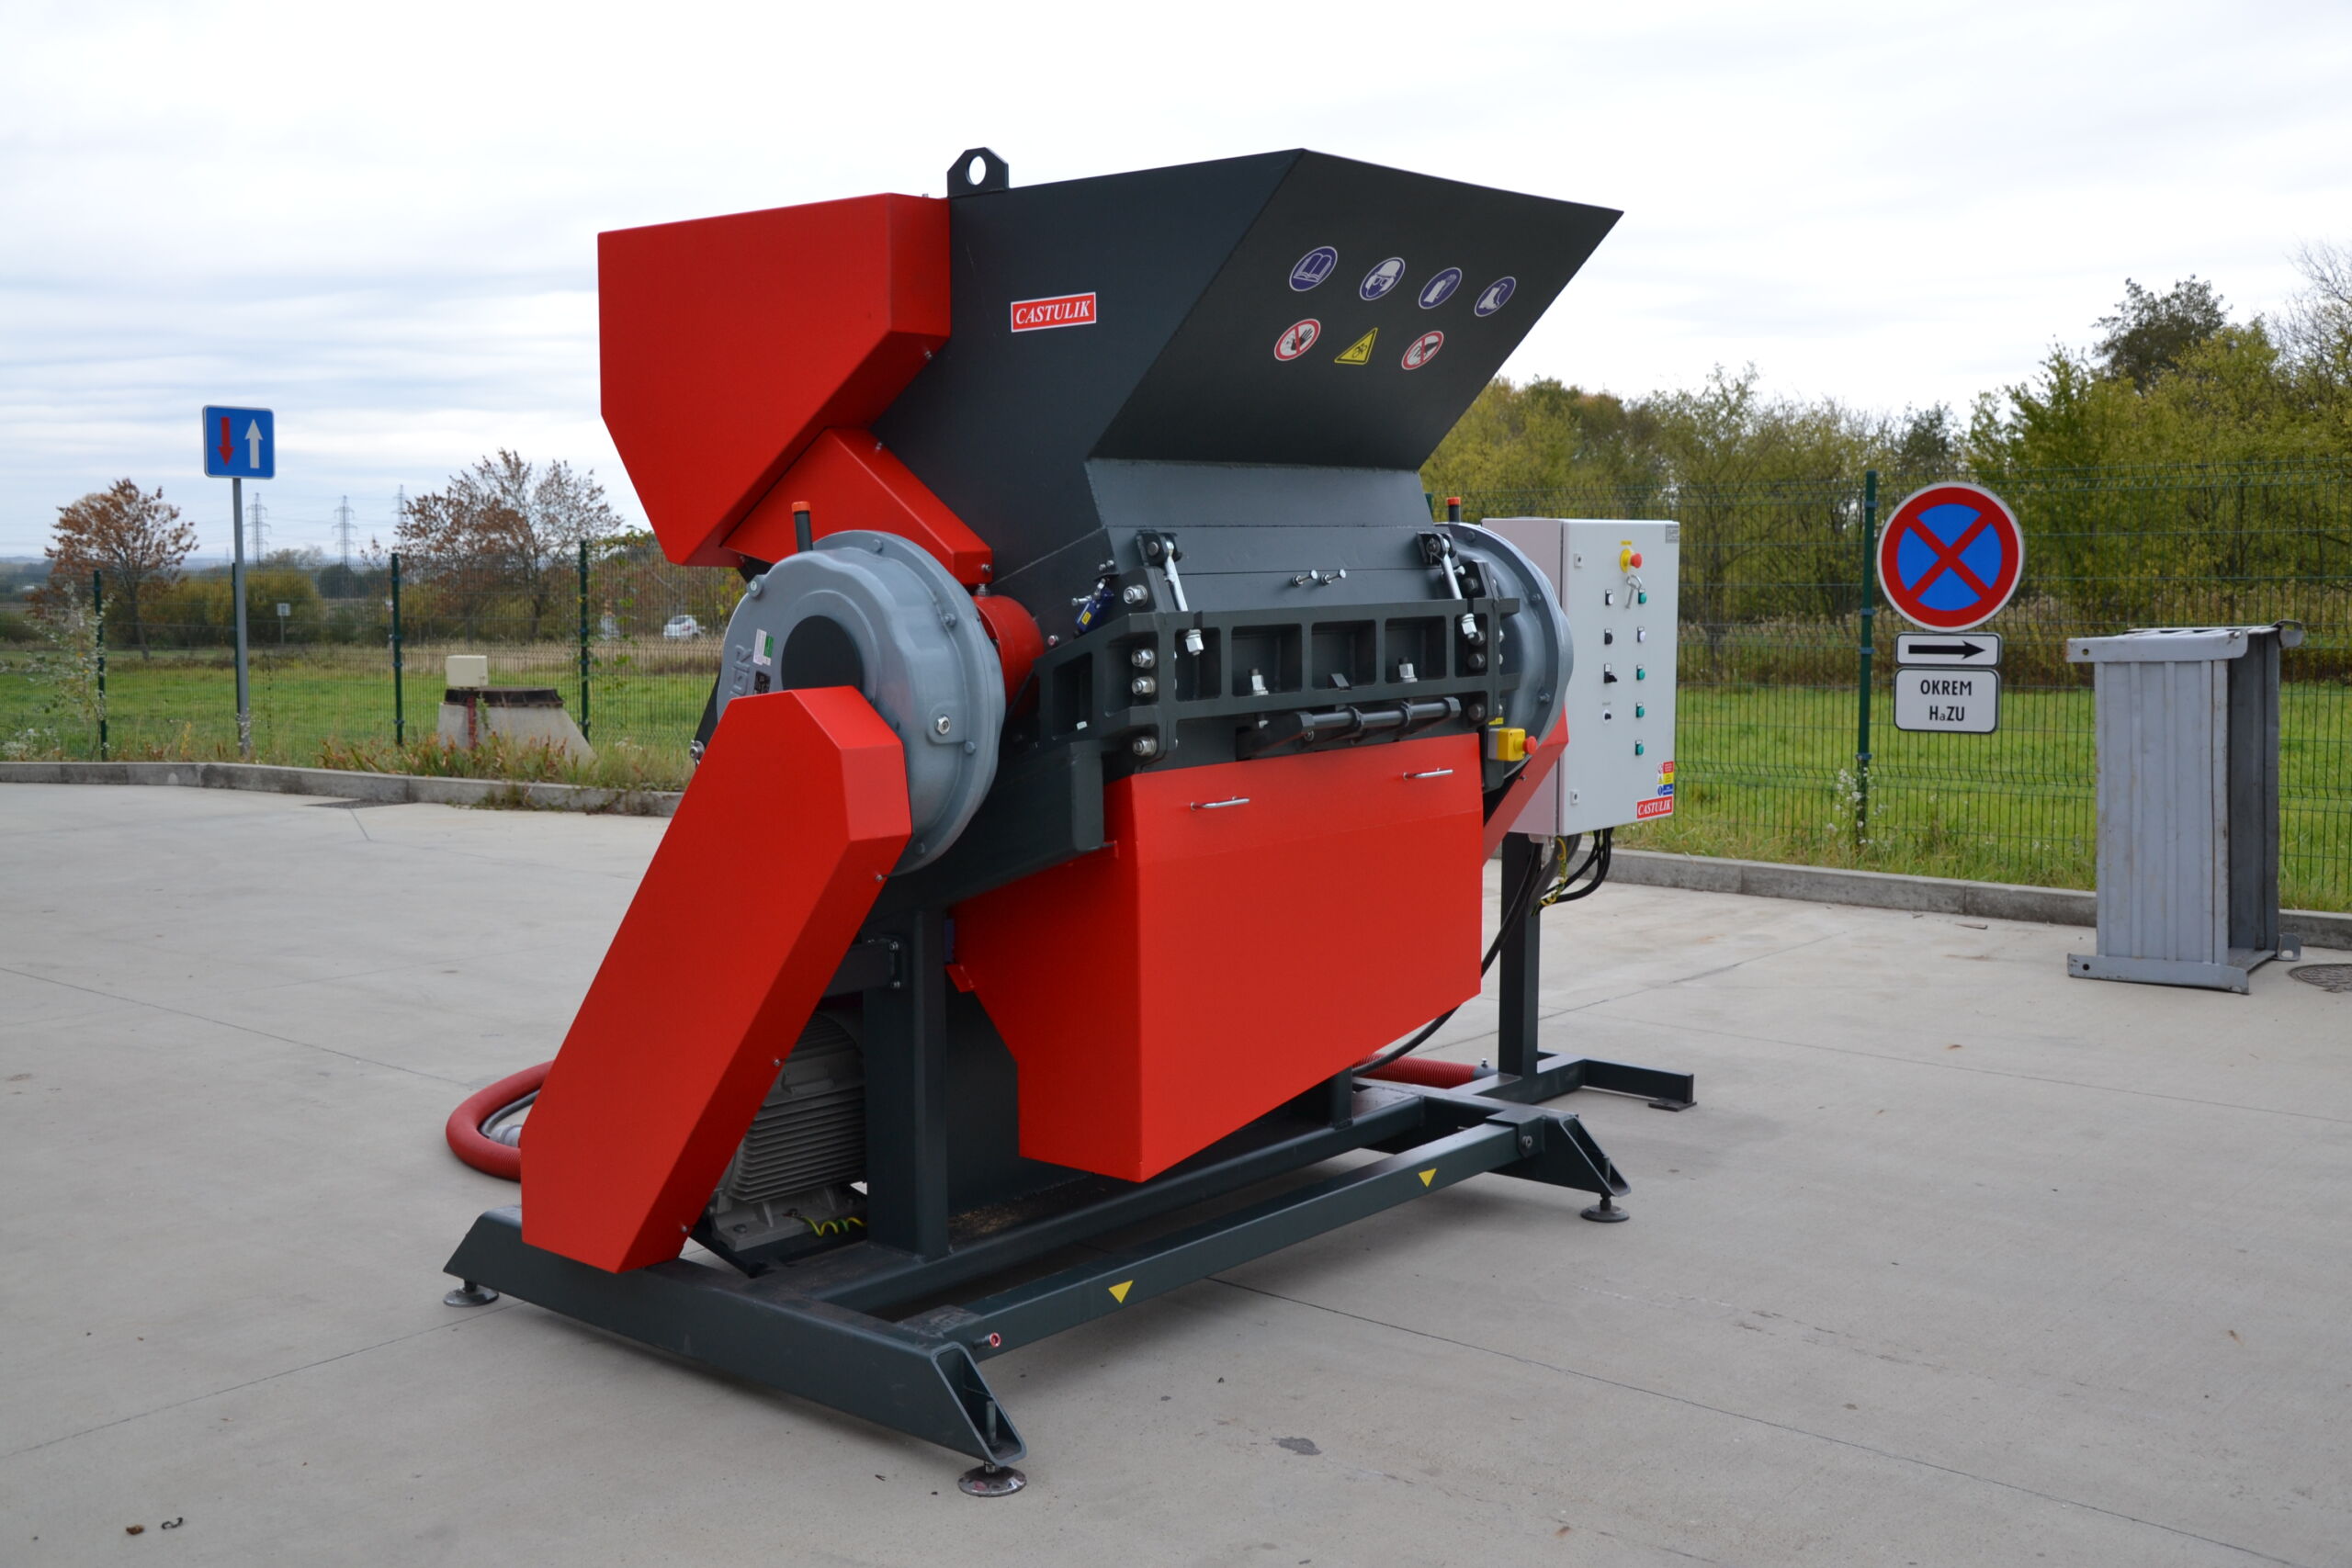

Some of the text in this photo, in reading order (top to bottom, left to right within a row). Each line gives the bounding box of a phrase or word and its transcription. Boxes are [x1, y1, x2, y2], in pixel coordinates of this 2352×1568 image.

[1015, 300, 1091, 324] CASTULIK
[1920, 680, 1972, 696] OKREM
[1928, 705, 1965, 721] HaZU
[1638, 798, 1671, 816] CASTULIK
